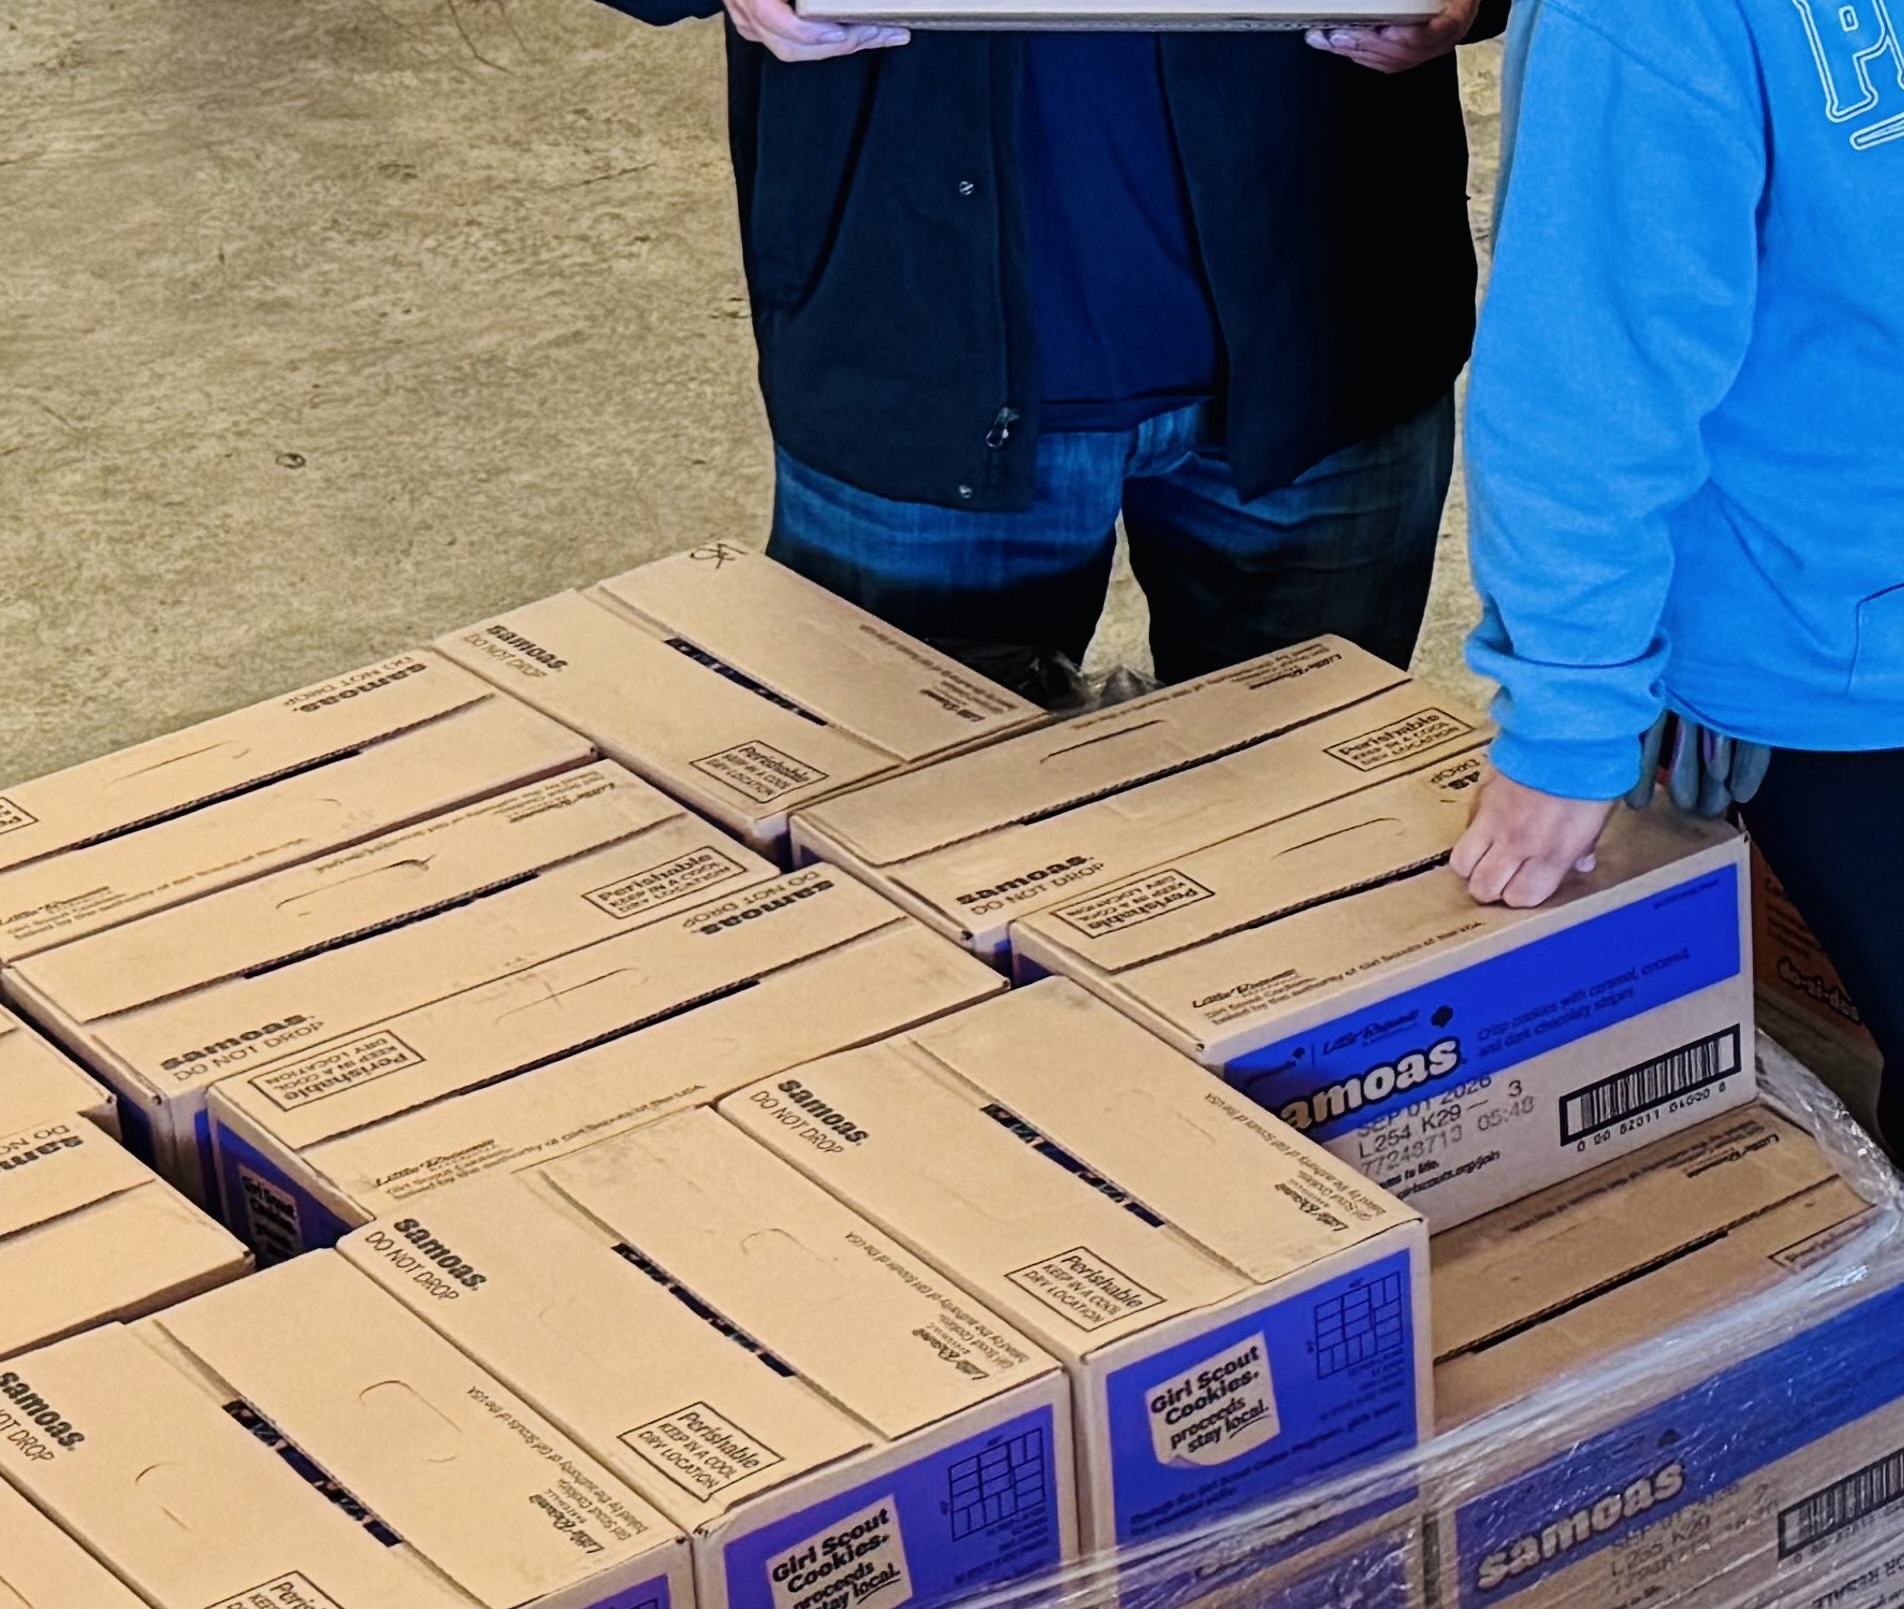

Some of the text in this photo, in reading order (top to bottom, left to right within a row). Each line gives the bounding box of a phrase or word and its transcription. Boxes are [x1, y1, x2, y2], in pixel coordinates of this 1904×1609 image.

[486, 625, 569, 672] samoas
[597, 854, 714, 902] Perishable
[954, 854, 1095, 908] samoas
[698, 880, 835, 935] samoas
[160, 1013, 316, 1072] samoas
[777, 1078, 870, 1147] samoas
[1279, 1038, 1461, 1133] amoas
[1421, 1104, 1462, 1131] K29
[1508, 1080, 1523, 1098] 3
[1441, 1076, 1492, 1105] 2026
[393, 1217, 488, 1292] samoas
[1151, 1345, 1260, 1414] Girl Scout
[1164, 1371, 1260, 1425] Cookies.
[0, 1371, 86, 1451] samoas
[1171, 1397, 1246, 1449] proceeds
[1188, 1399, 1270, 1453] stay local.
[676, 1410, 760, 1470] Perishable
[1474, 1458, 1687, 1590] samoas
